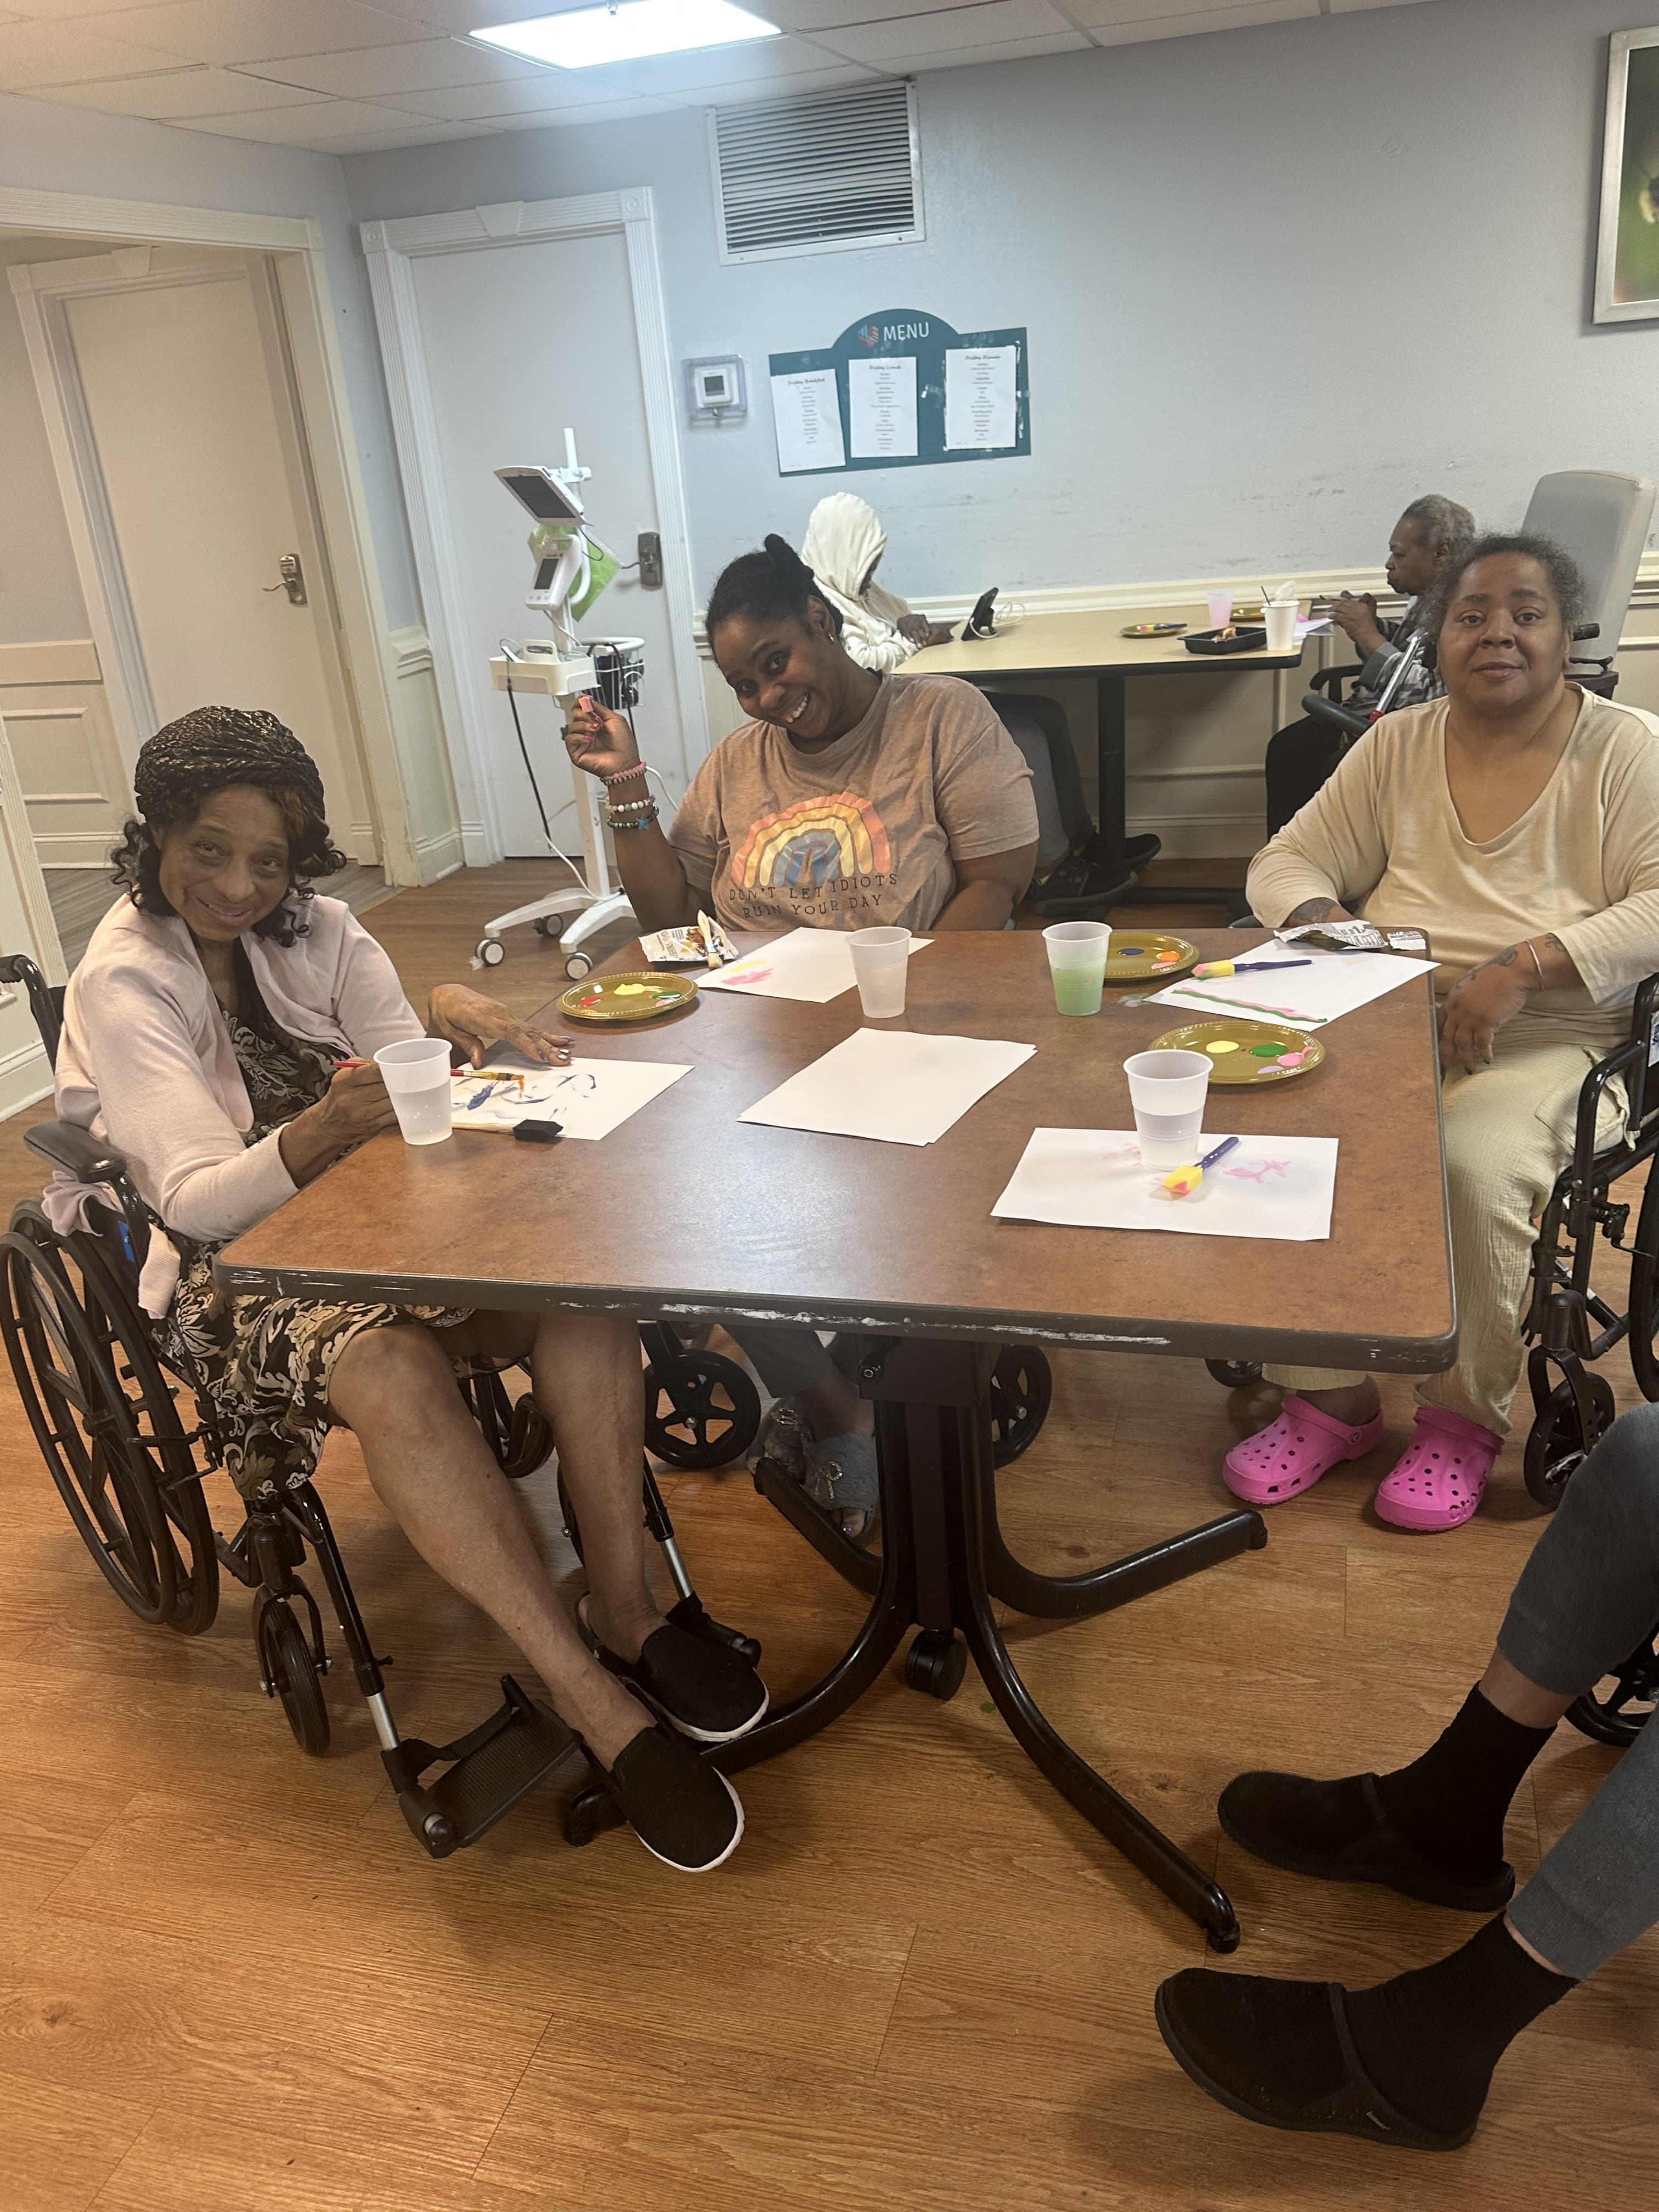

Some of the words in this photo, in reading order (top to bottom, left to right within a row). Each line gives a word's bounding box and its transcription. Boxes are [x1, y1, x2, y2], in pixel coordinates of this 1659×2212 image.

[883, 321, 929, 342] MENU
[730, 887, 776, 900] DON'T
[789, 886, 822, 899] LET
[831, 873, 897, 892] IDIOTS
[742, 905, 782, 918] RUIN
[791, 900, 839, 915] YOUR
[849, 895, 881, 909] DAY
